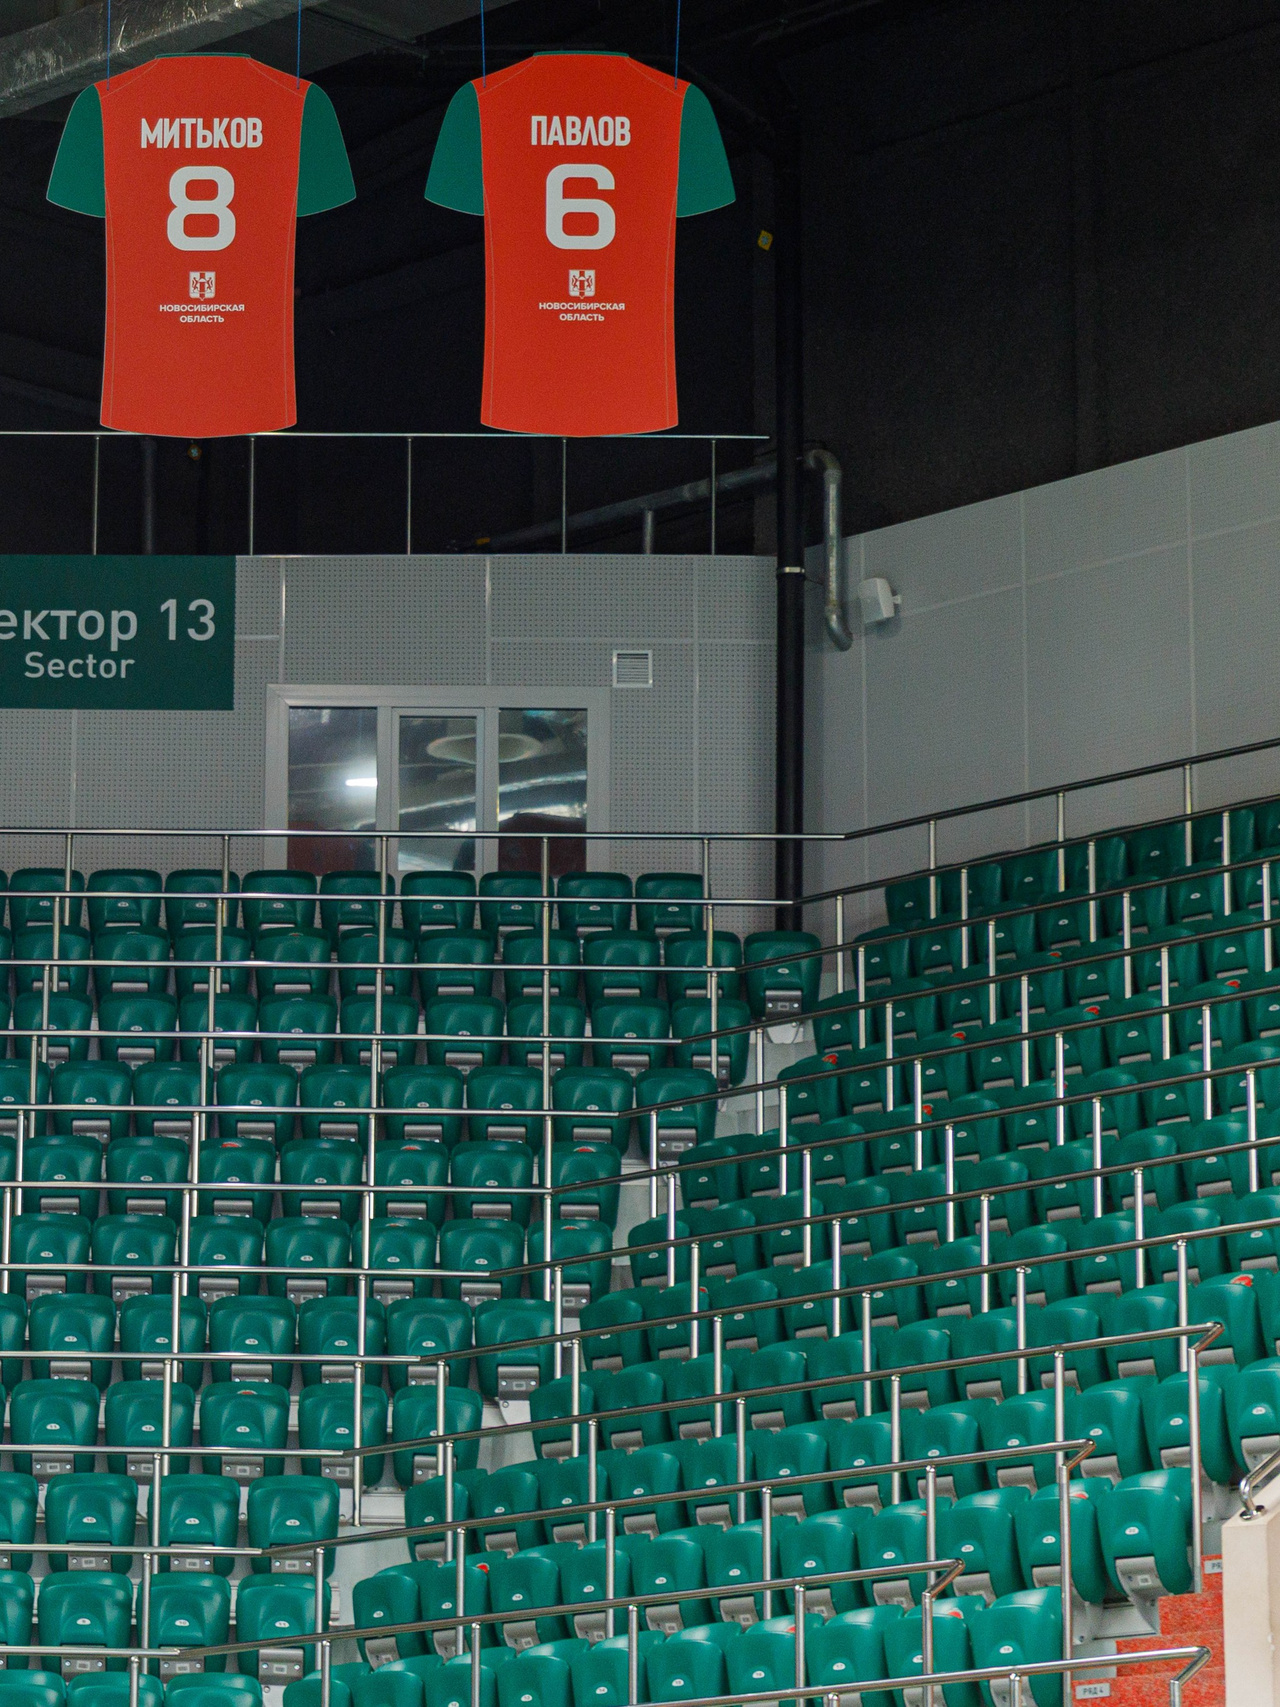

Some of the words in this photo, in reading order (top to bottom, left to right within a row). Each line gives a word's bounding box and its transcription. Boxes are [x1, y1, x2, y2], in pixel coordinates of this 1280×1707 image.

[140, 117, 263, 149] МИТЬКОВ
[530, 115, 631, 147] ПАВЛОВ
[166, 165, 236, 252] 8
[545, 163, 616, 250] 6
[159, 302, 246, 313] НОВОСИБИРСКАЯ
[179, 314, 226, 323] ОБЛАСТЬ
[538, 301, 626, 311] НОВОСИБИРСКАЯ
[558, 312, 605, 322] ОБЛАСТЬ
[160, 598, 216, 641] 13
[24, 651, 136, 679] Sector
